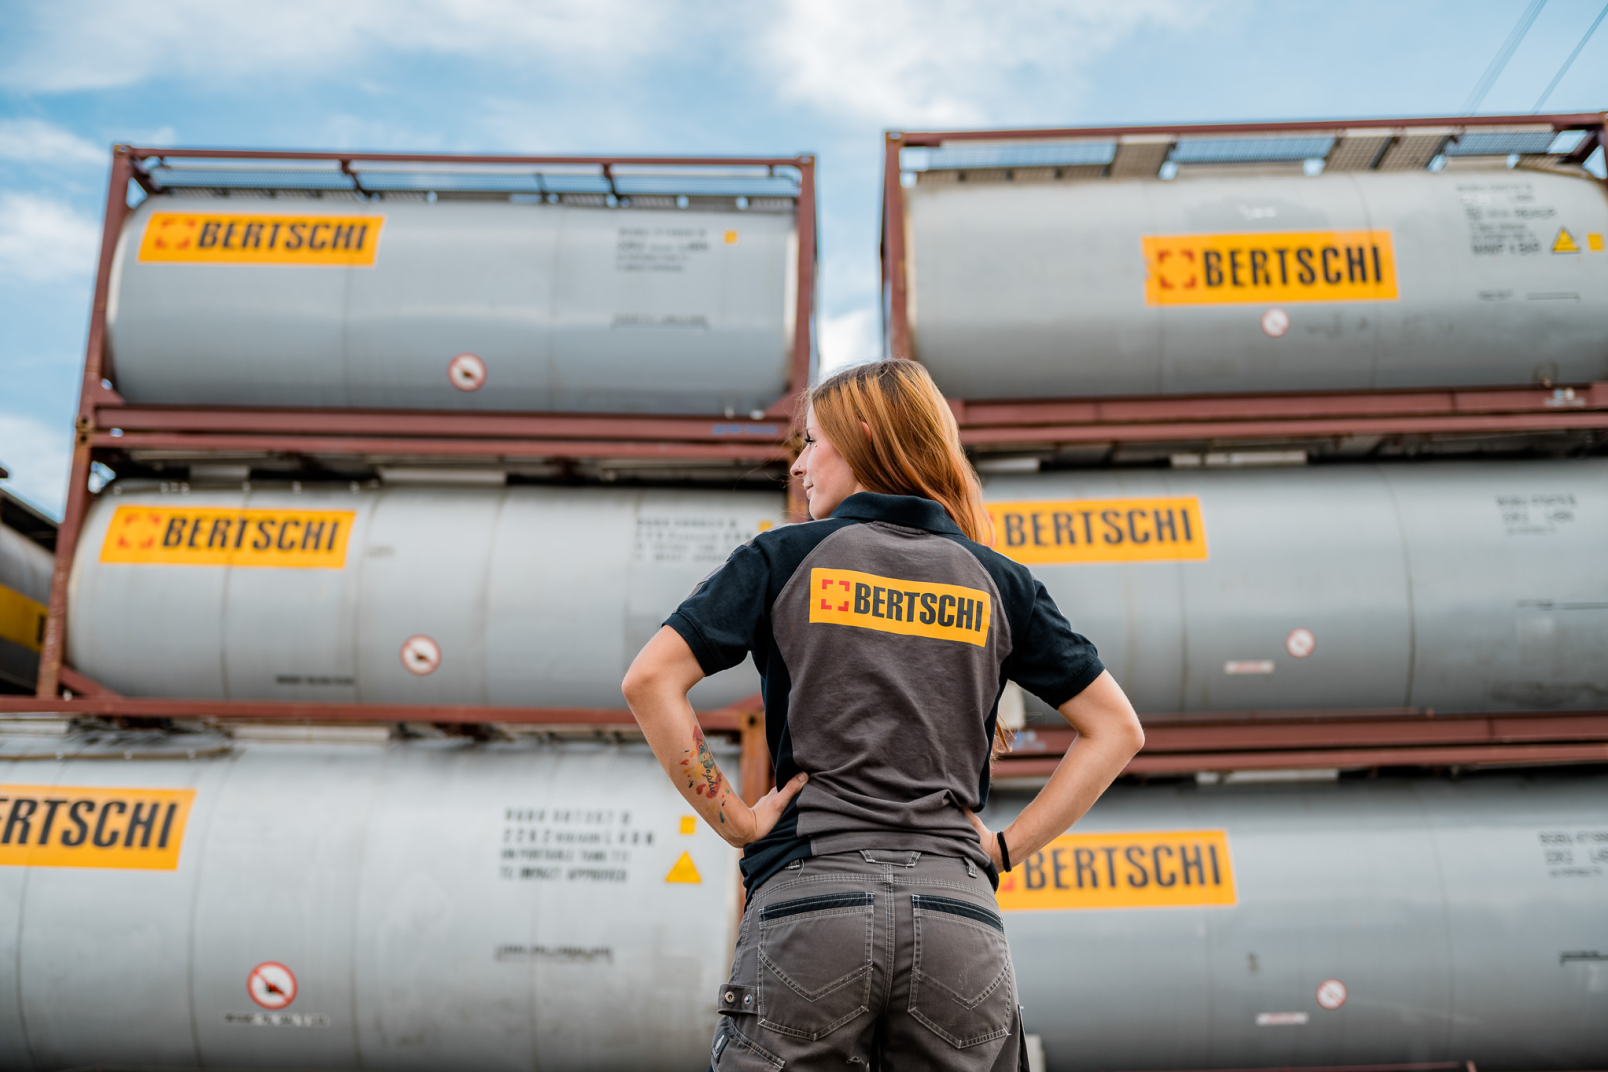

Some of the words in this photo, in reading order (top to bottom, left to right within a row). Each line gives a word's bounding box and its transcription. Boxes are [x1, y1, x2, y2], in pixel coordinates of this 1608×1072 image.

[198, 222, 368, 250] BERTSCHI
[1203, 245, 1383, 288] BERTSCHI
[162, 517, 339, 551] BERTSCHI
[1004, 508, 1193, 547] BERTSCHI
[854, 582, 983, 632] BERTSCHI
[1024, 843, 1222, 890] BERTSCHI
